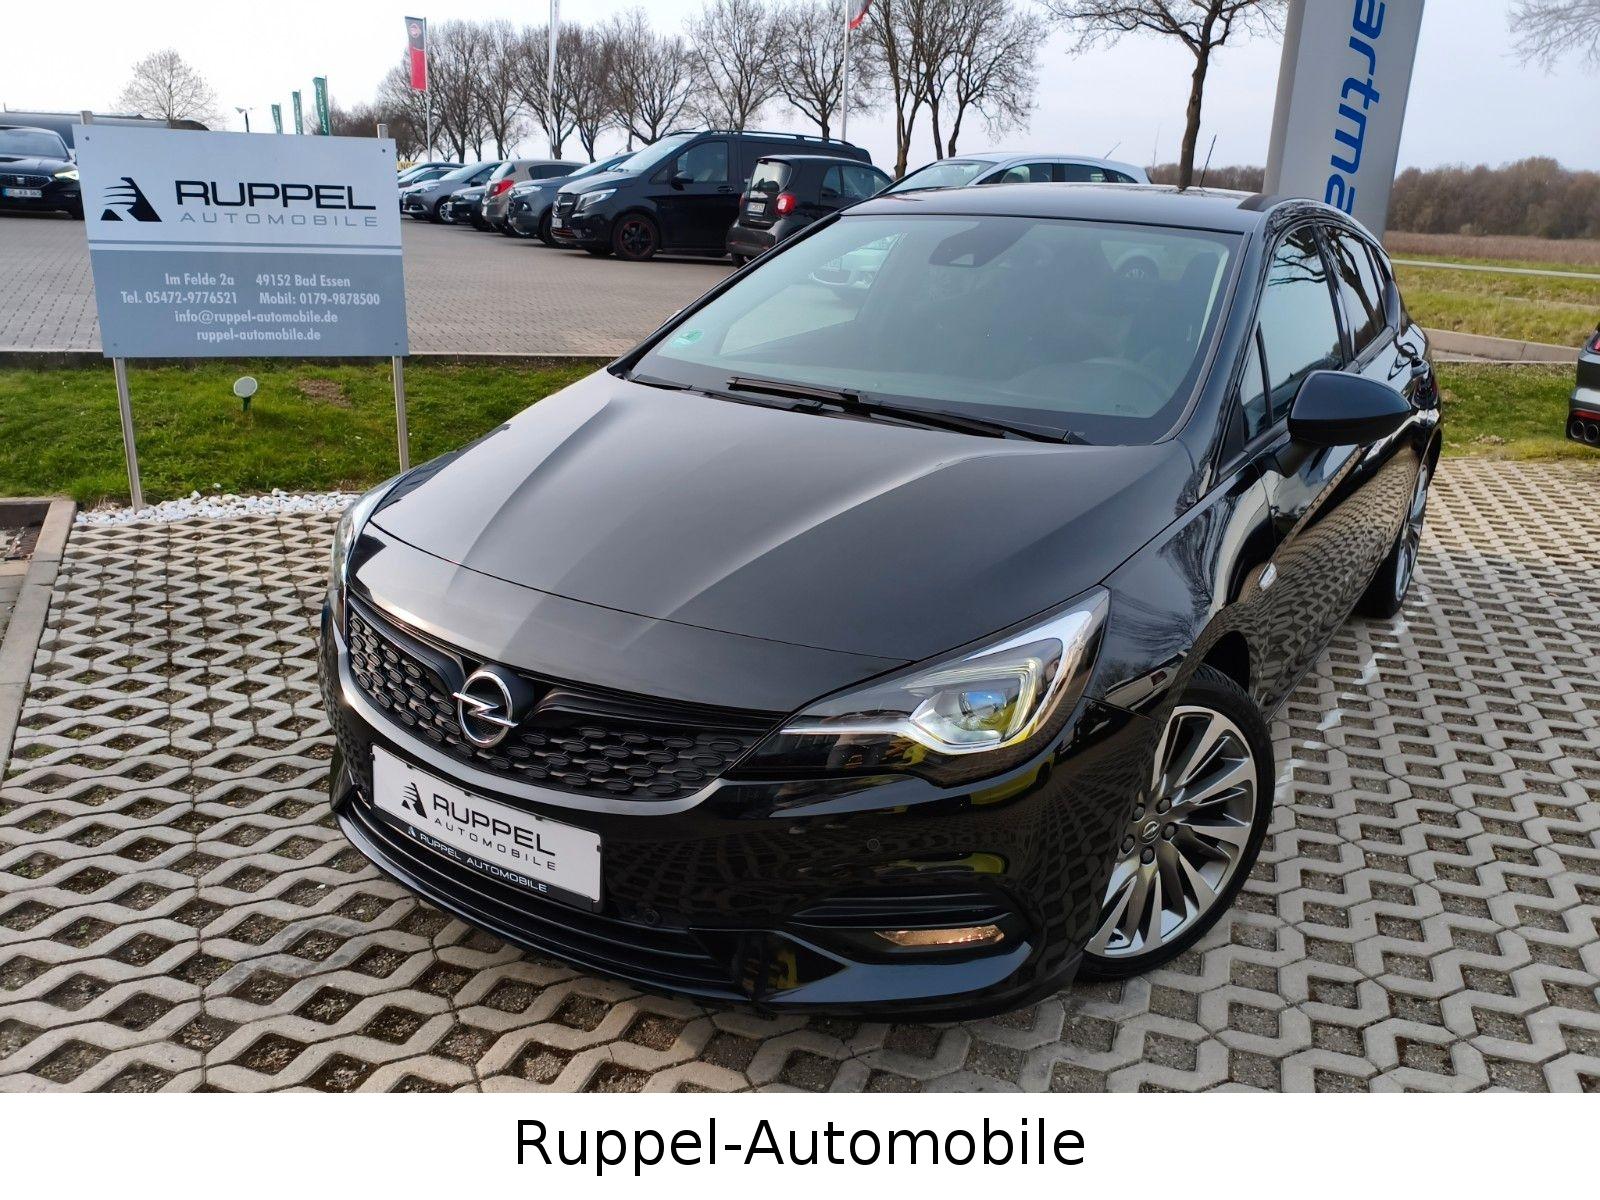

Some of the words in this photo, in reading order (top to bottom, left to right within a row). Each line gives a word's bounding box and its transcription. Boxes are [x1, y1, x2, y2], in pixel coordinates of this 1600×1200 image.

[175, 180, 376, 211] RUPPEL
[180, 212, 378, 227] AUTOMOBILE
[165, 272, 180, 285] Im
[184, 272, 216, 286] Felde
[220, 273, 235, 286] 2a
[256, 274, 291, 286] 49152
[295, 273, 317, 287] Bad
[320, 274, 351, 287] Essen
[121, 290, 142, 304] Tel.
[145, 291, 237, 304] 05472-9776521
[260, 291, 296, 305] Mobil:
[300, 292, 380, 306] 0179-9878500
[175, 309, 338, 325] info@ruppel-automobile.de
[197, 327, 321, 343] ruppel-automobile.de
[433, 793, 556, 857] RUPPEL
[434, 817, 557, 871] AUTOMOBILE
[420, 833, 462, 861] RUPPEL
[466, 857, 548, 893] AUTOMOBILE
